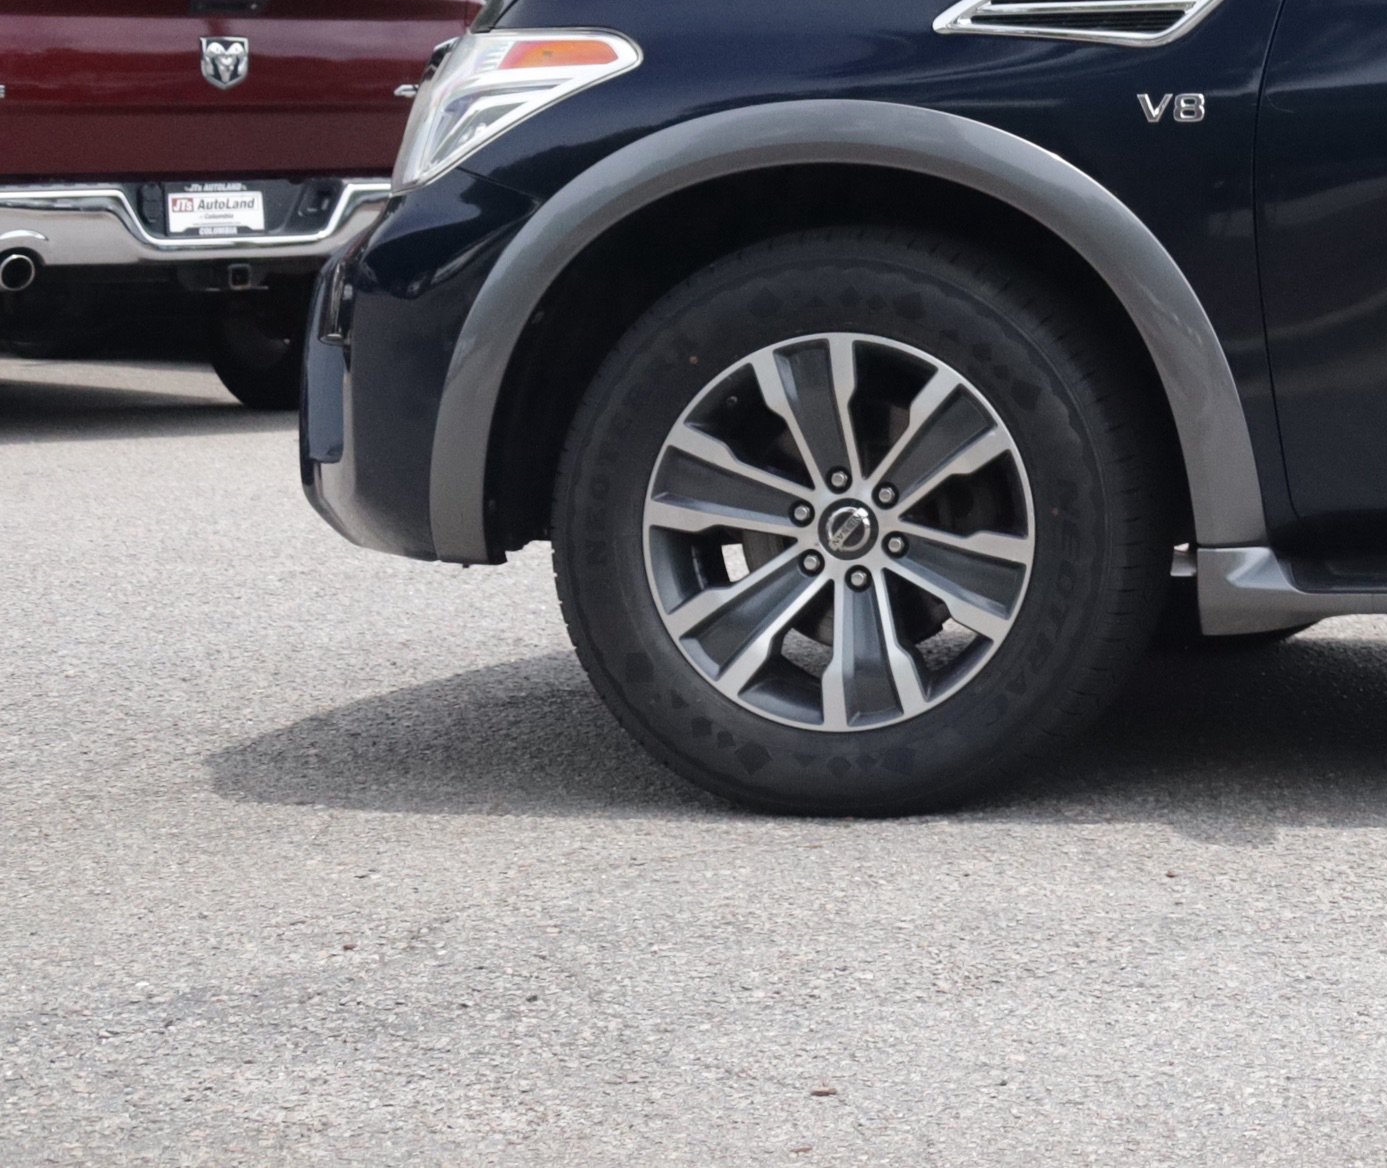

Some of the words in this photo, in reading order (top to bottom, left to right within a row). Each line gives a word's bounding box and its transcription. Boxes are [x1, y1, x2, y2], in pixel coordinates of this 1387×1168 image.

[1136, 93, 1205, 123] V8
[173, 198, 194, 212] JTs
[198, 197, 255, 210] AutoLand
